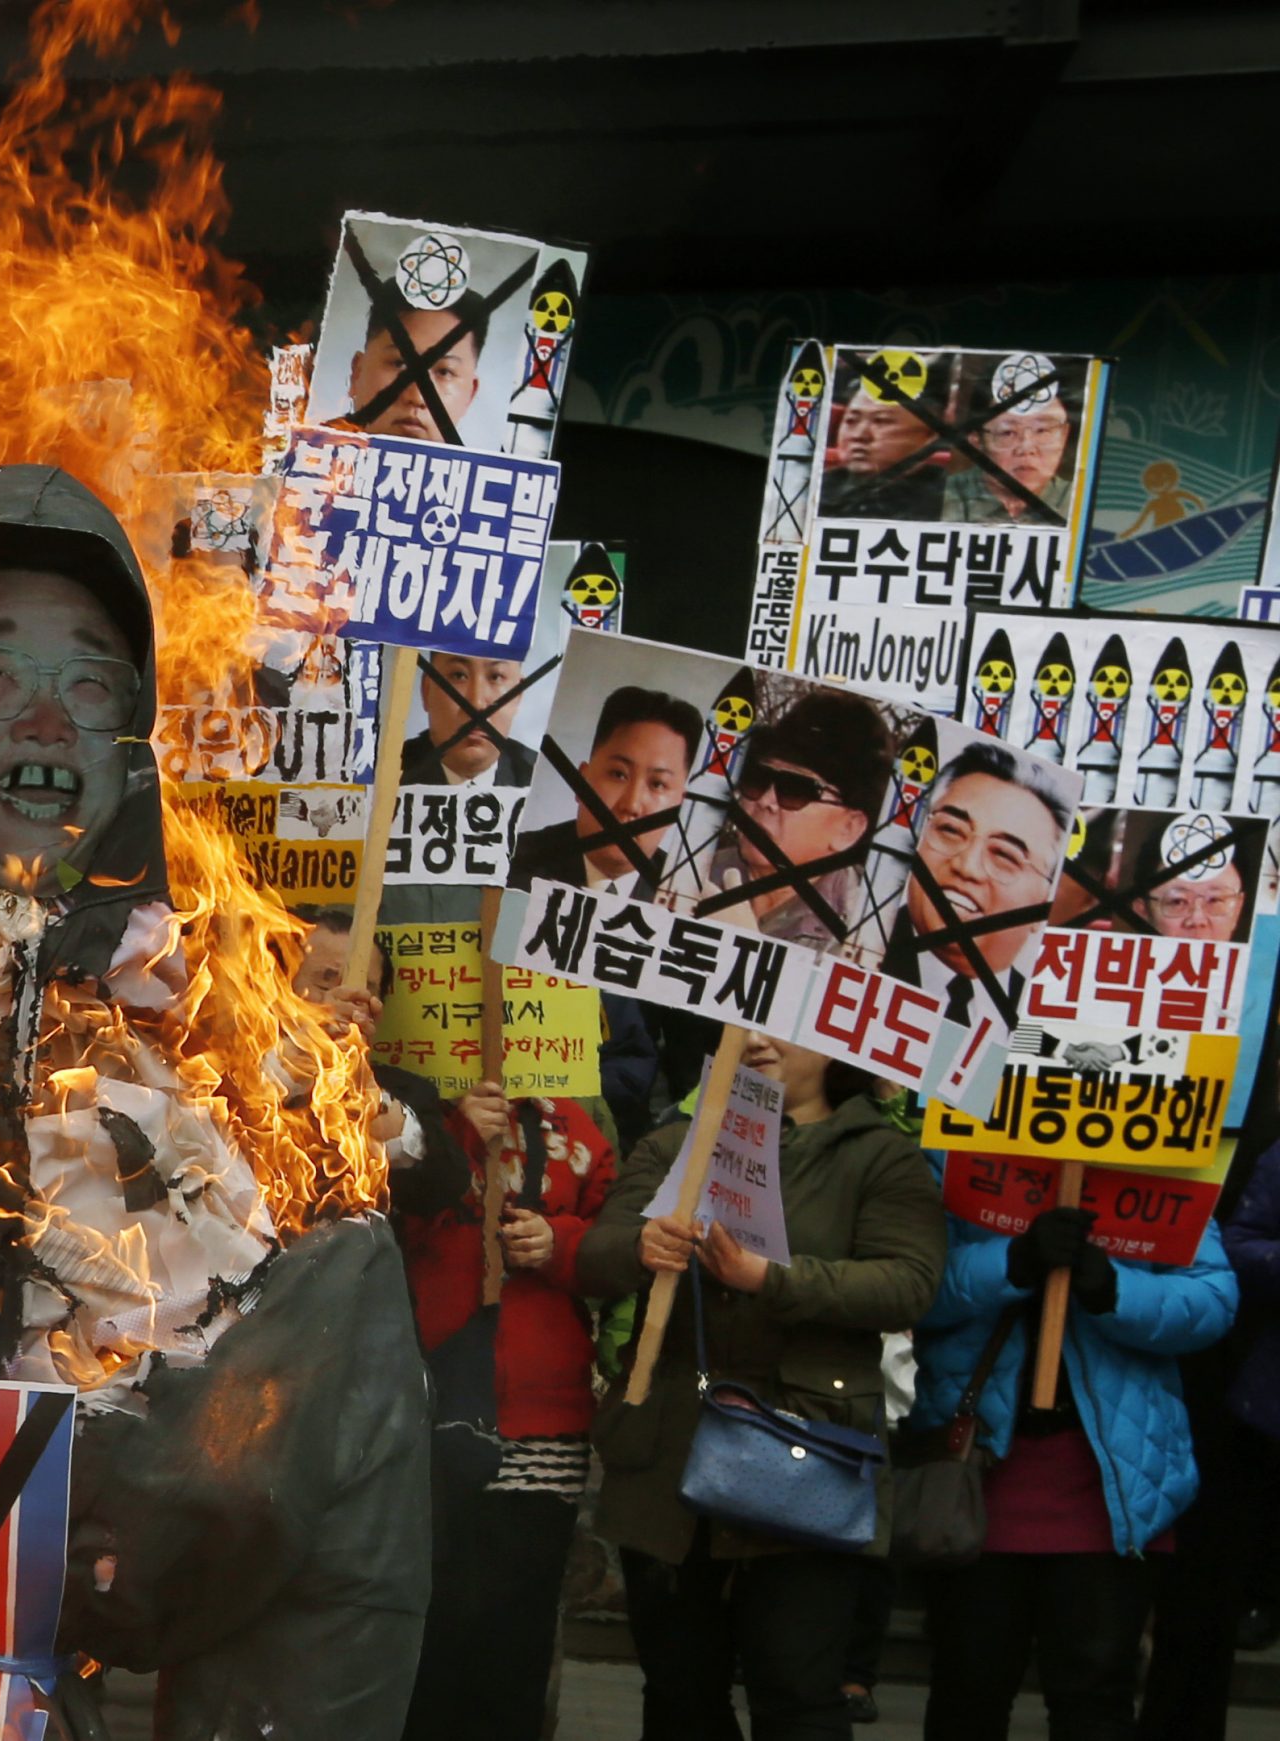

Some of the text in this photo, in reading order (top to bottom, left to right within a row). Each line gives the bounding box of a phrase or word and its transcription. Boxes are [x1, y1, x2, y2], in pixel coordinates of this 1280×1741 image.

[815, 528, 1061, 608] 무수단발사
[525, 887, 788, 1025] 세습독재
[1115, 1186, 1195, 1226] OUT
